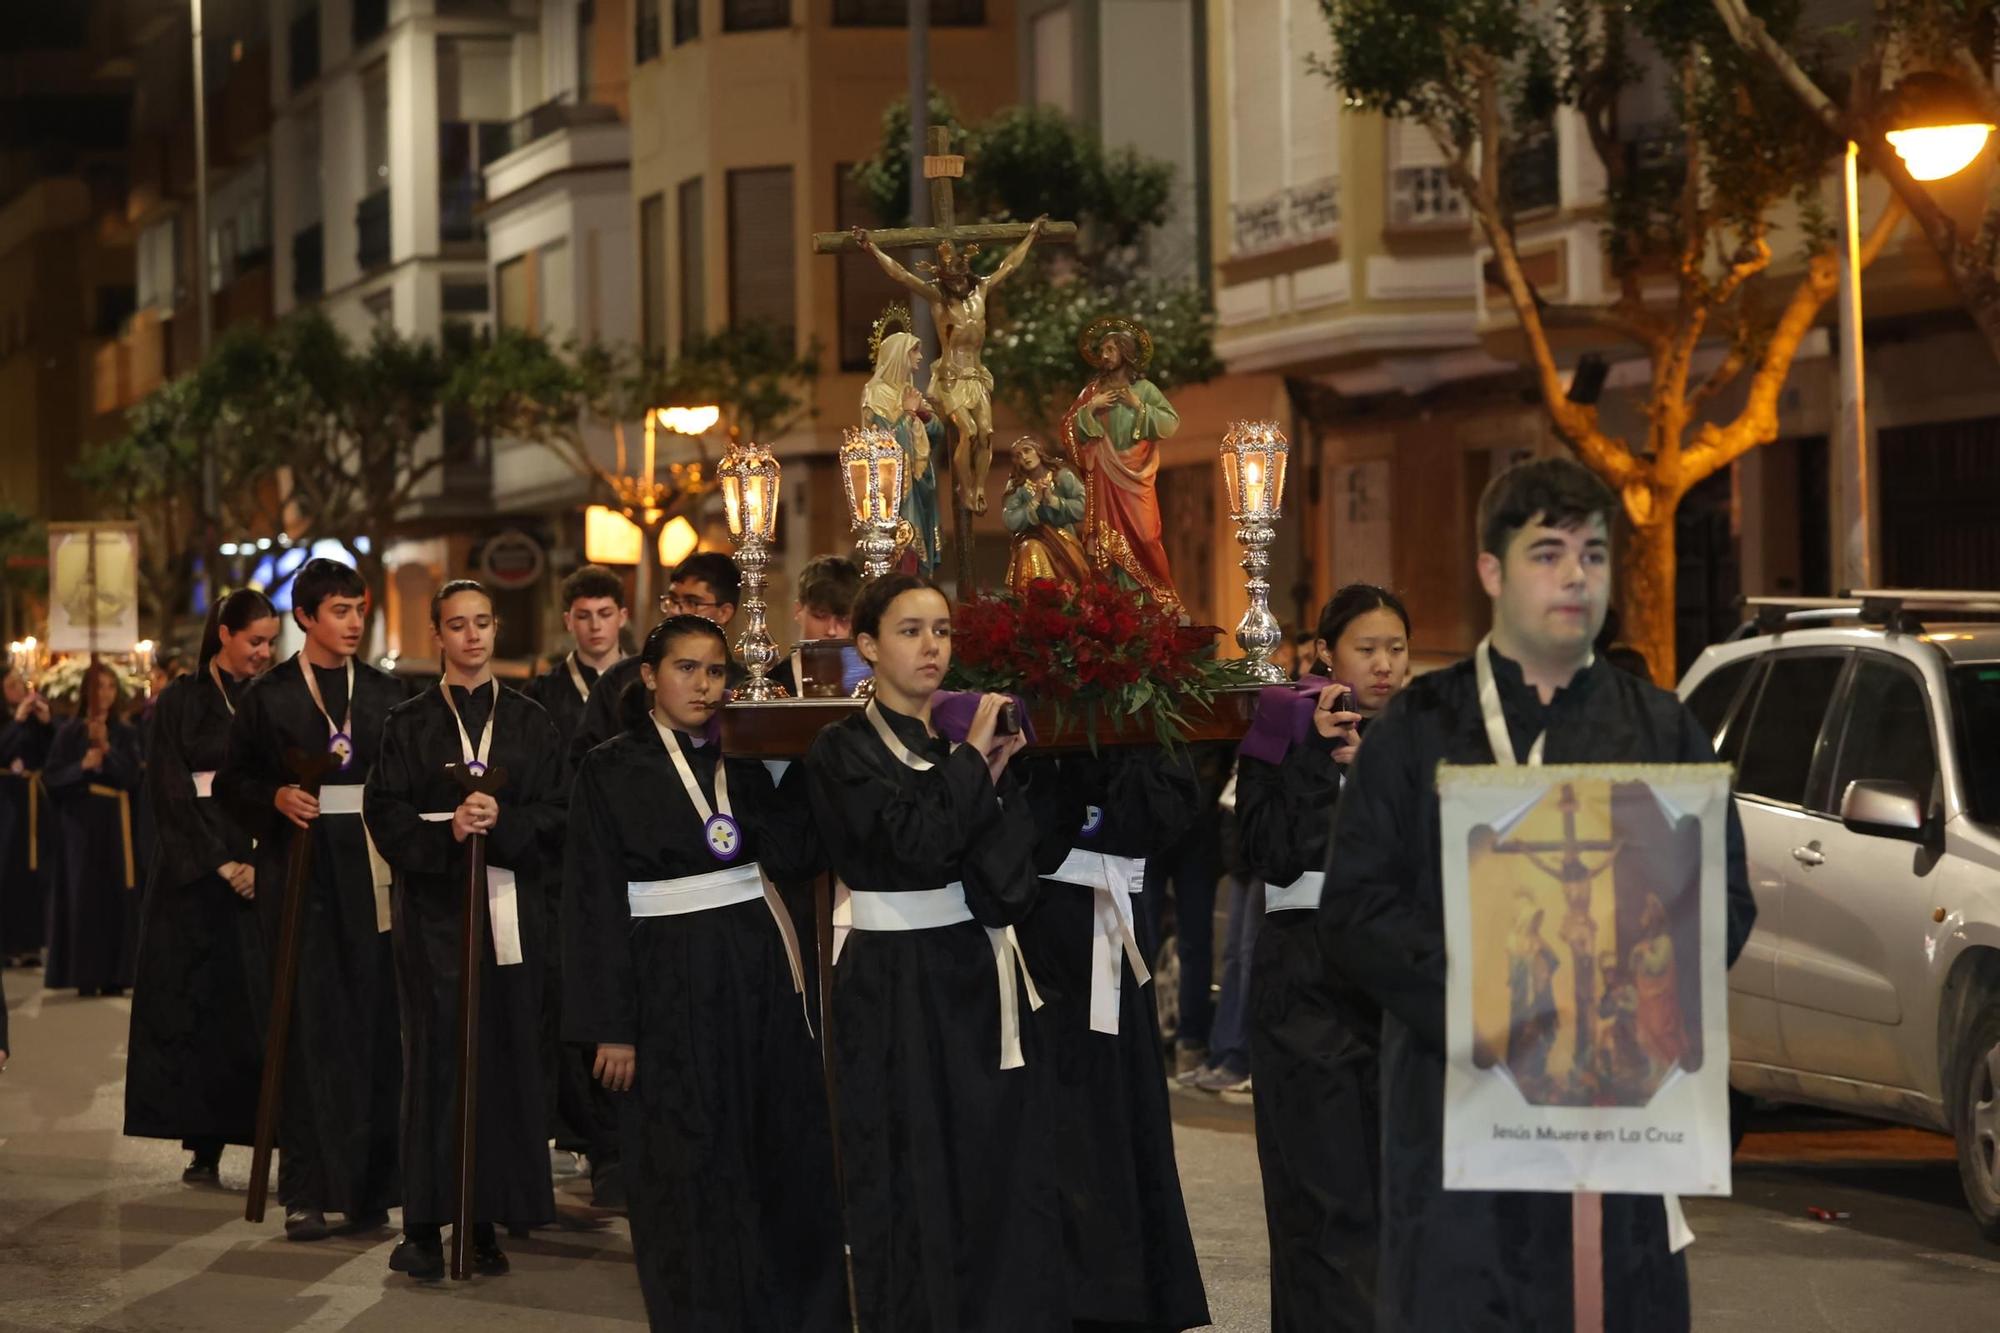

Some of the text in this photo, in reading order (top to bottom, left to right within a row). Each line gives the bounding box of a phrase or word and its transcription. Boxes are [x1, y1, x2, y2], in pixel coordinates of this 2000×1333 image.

[1493, 1124, 1684, 1143] Jesús Muere en La Cruz
